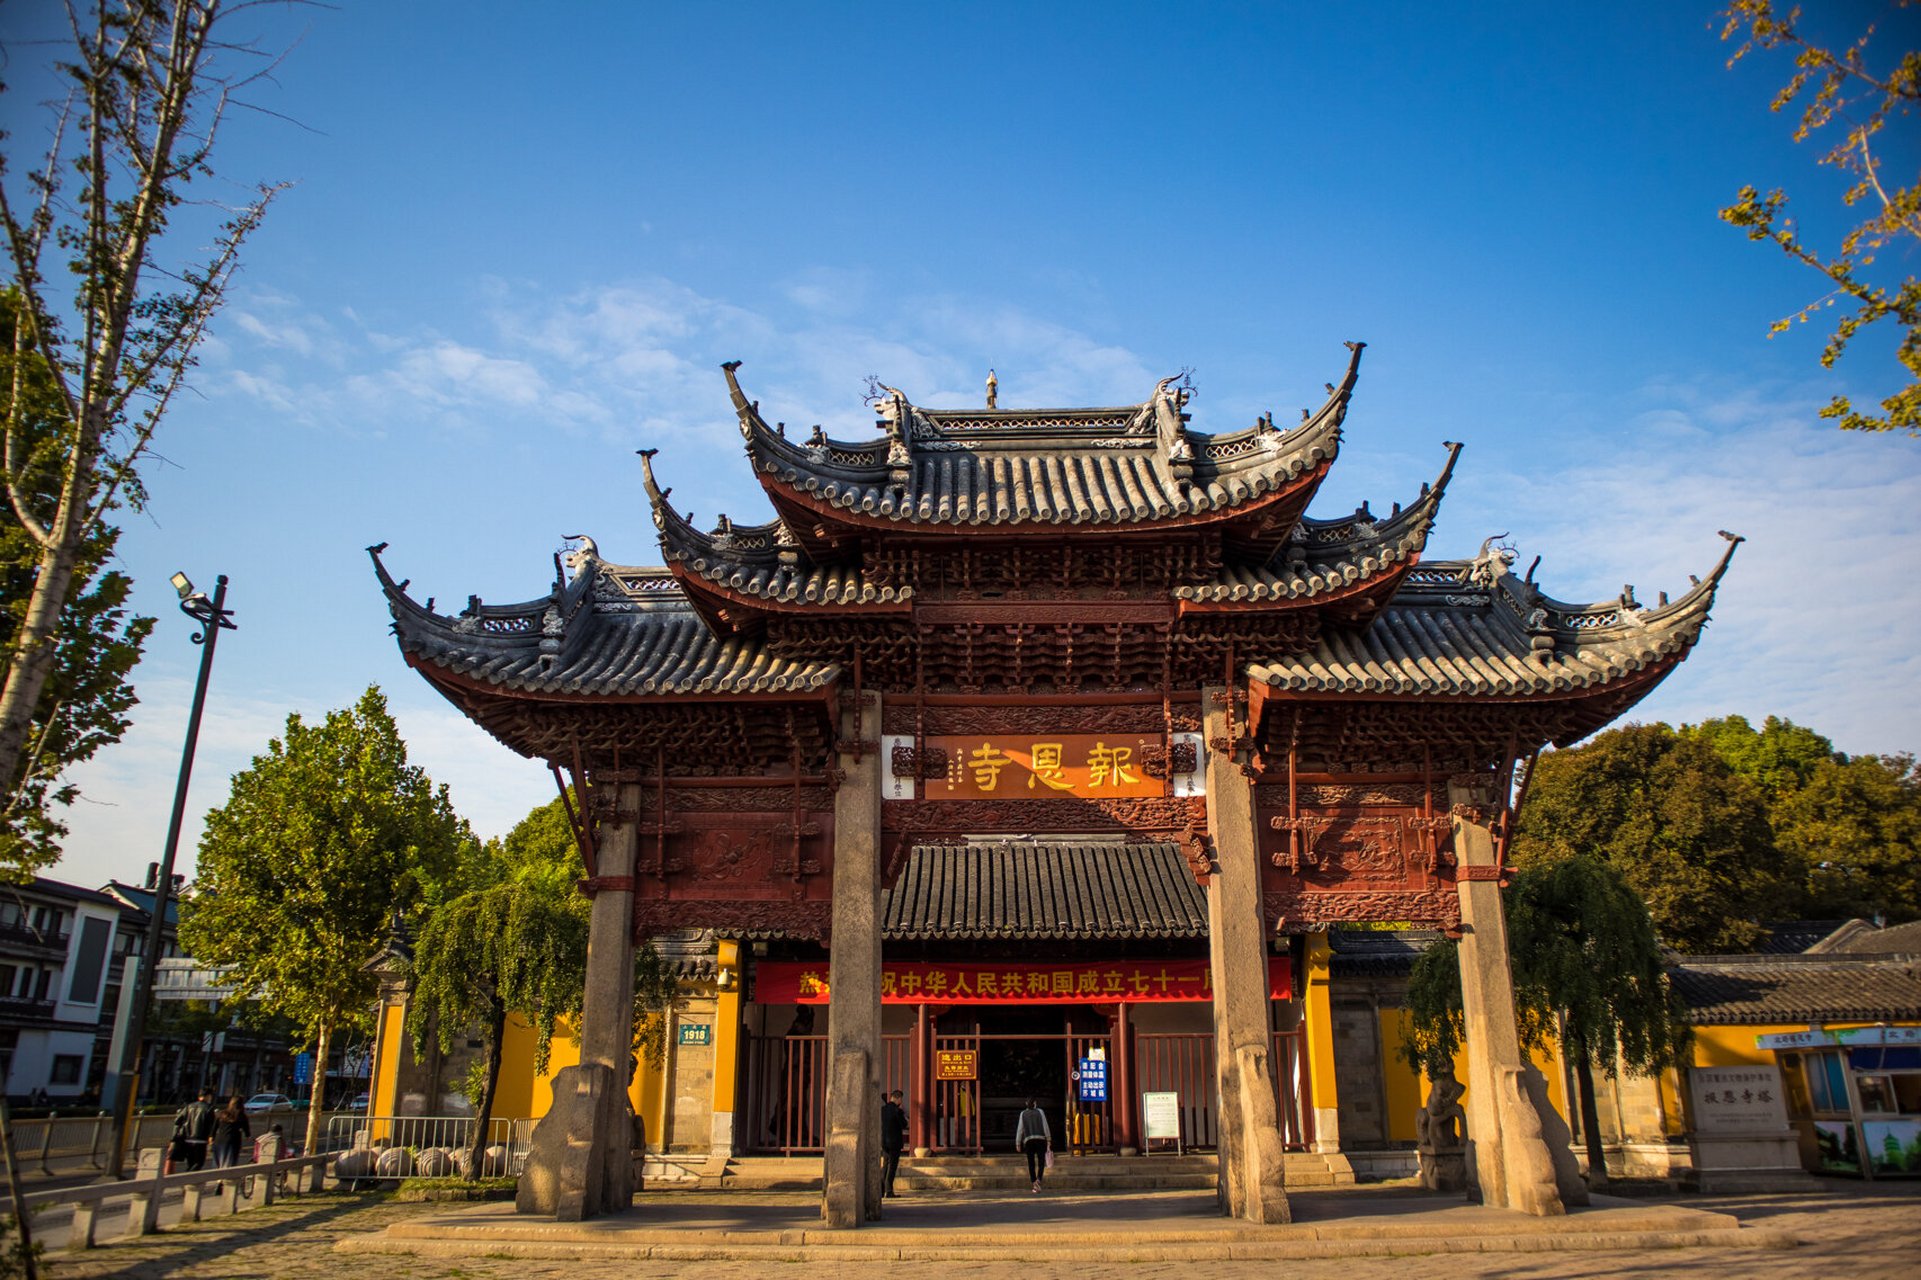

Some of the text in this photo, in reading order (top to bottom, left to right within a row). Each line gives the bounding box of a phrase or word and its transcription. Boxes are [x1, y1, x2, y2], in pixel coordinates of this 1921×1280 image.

[967, 742, 1142, 791] 報恩寺
[684, 1030, 705, 1040] 1918
